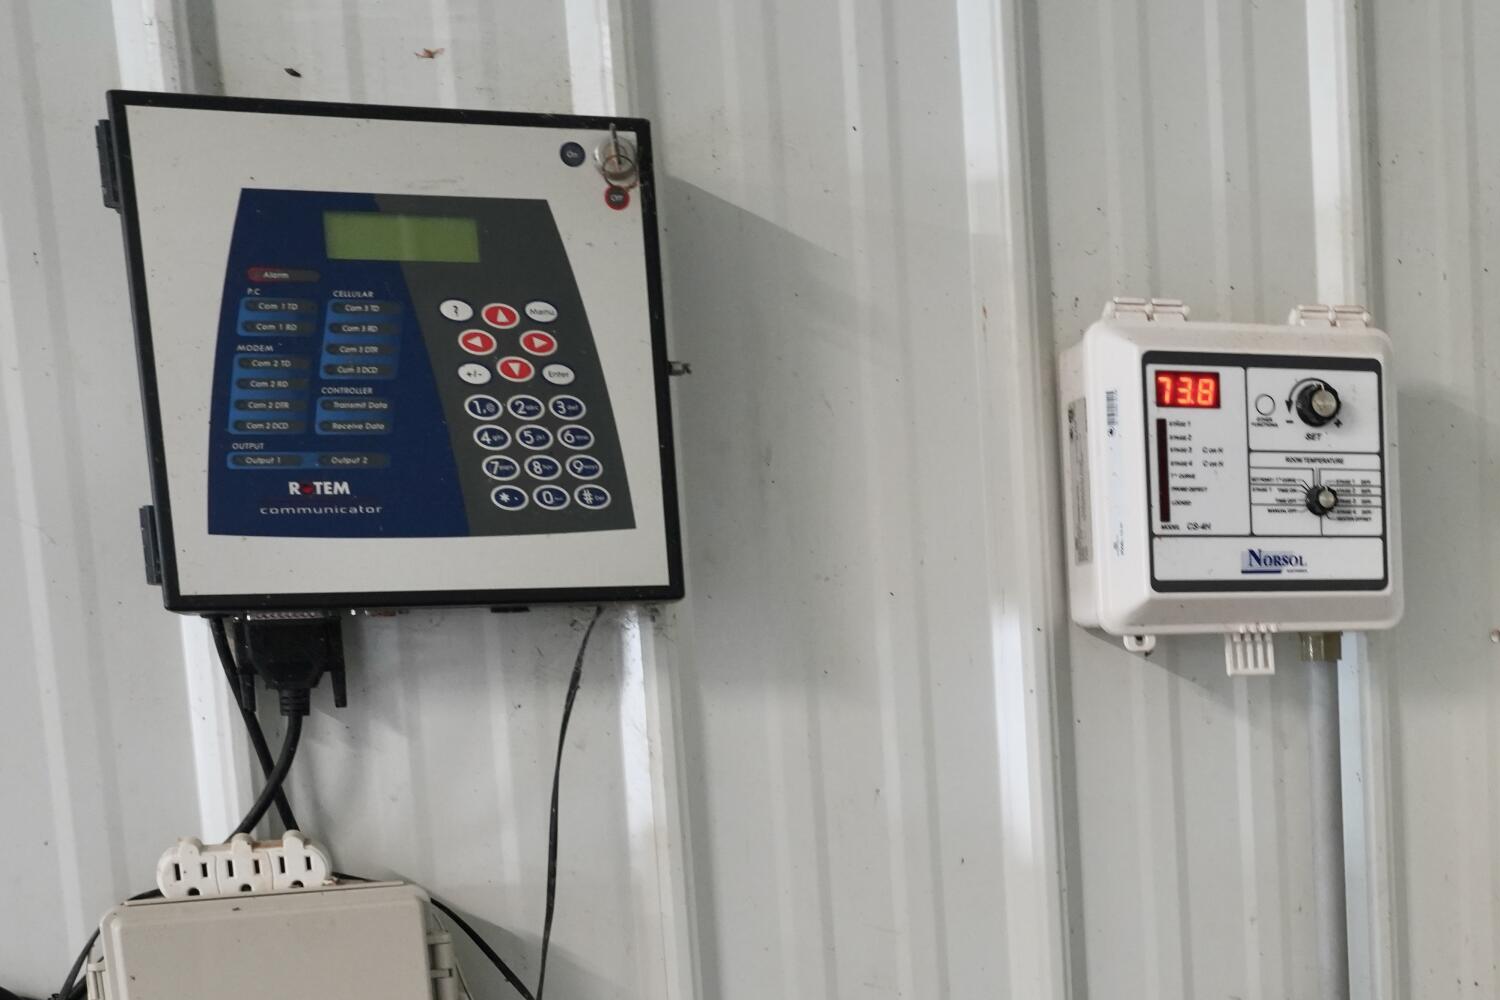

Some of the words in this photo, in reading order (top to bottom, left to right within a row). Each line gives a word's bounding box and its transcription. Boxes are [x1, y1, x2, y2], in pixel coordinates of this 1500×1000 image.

[566, 151, 578, 159] On
[263, 271, 289, 279] Alarm
[333, 290, 374, 298] CELLULAR
[258, 302, 278, 311] Com
[287, 302, 298, 311] TD
[256, 323, 276, 331] Com
[285, 323, 298, 331] RD
[342, 325, 360, 333] Com
[367, 325, 378, 333] RD
[251, 359, 271, 367] Com
[273, 359, 278, 367] 2
[281, 359, 292, 367] TD
[337, 366, 354, 374] Com
[362, 366, 378, 374] DCD
[250, 380, 269, 388] Com
[277, 380, 289, 388] RD
[1158, 376, 1215, 406] 73.8
[248, 401, 266, 409] Com
[275, 401, 289, 409] DTR
[333, 401, 367, 409] Transmit
[368, 401, 388, 409] Data
[514, 400, 527, 415] 2
[556, 400, 567, 415] 3
[246, 422, 265, 430] Com
[272, 422, 289, 430] DCD
[332, 422, 363, 430] Receive
[365, 422, 385, 430] Data
[480, 431, 492, 444] 4
[523, 430, 534, 444] 5
[563, 430, 575, 444] 6
[245, 457, 274, 465] Output
[331, 457, 360, 465] Output
[490, 461, 500, 475] 7
[532, 460, 543, 474] 8
[573, 460, 583, 473] 9
[542, 491, 553, 504] 0
[260, 505, 383, 514] communicator
